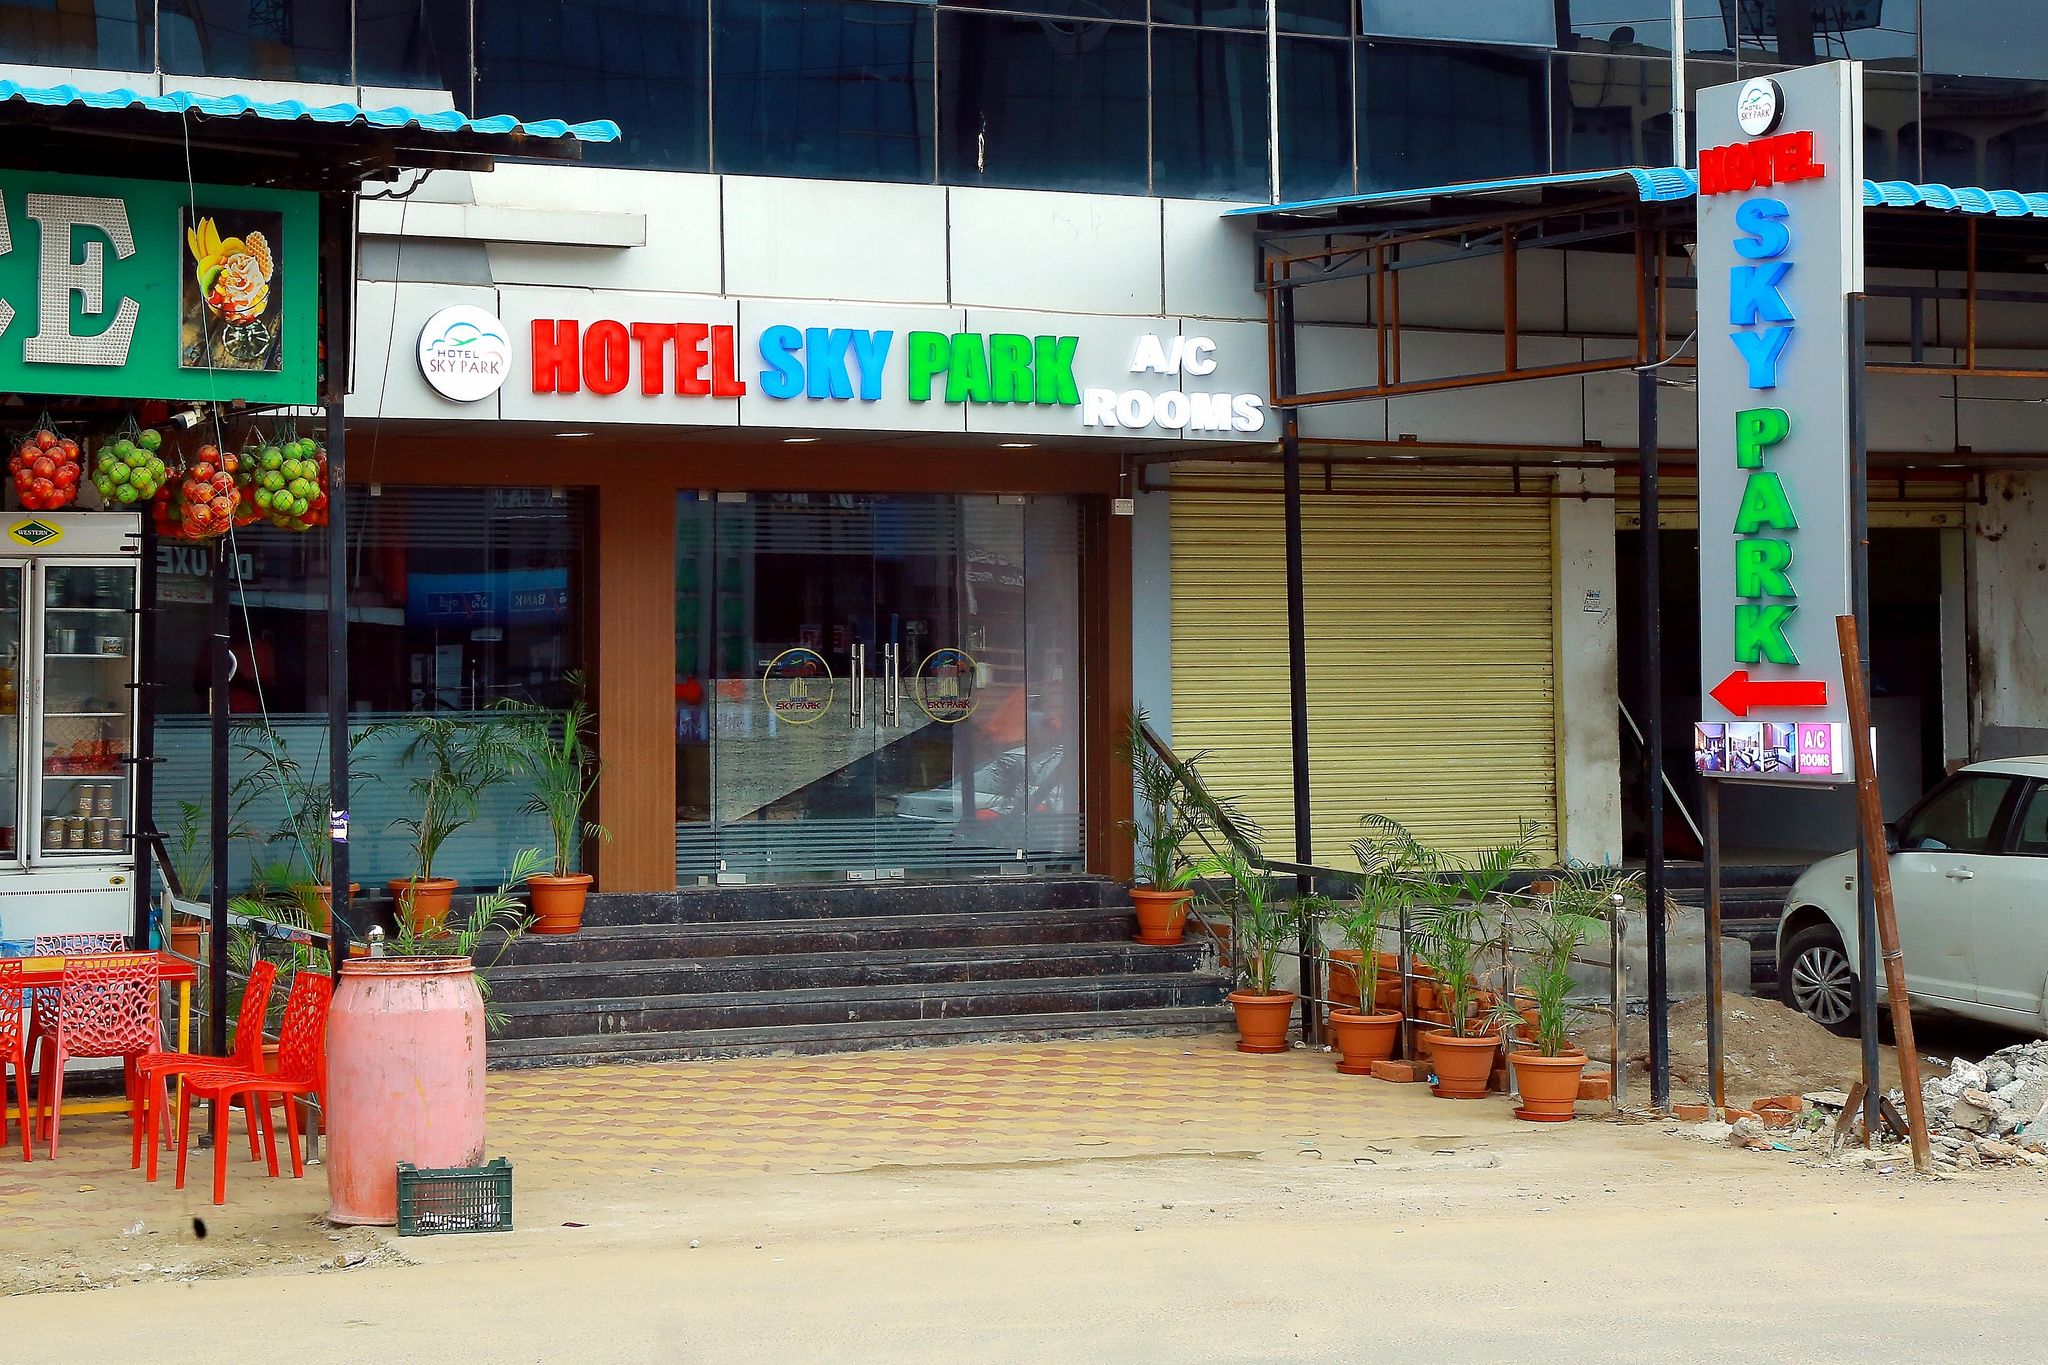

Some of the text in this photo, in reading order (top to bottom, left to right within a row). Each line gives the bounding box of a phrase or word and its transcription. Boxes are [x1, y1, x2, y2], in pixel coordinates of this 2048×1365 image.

[1753, 109, 1770, 119] PARK
[1699, 131, 1826, 195] HOTEL
[0, 187, 140, 366] E
[1729, 198, 1796, 390] SKY
[429, 359, 500, 375] SKY PARK
[437, 349, 479, 359] HOTEL
[531, 319, 1081, 405] HOTEL SKY PARK
[1129, 334, 1217, 376] A/C
[1083, 388, 1265, 432] ROOMS
[1733, 407, 1800, 665] PARK
[1800, 753, 1830, 767] ROOMS
[1804, 730, 1826, 749] A/C
